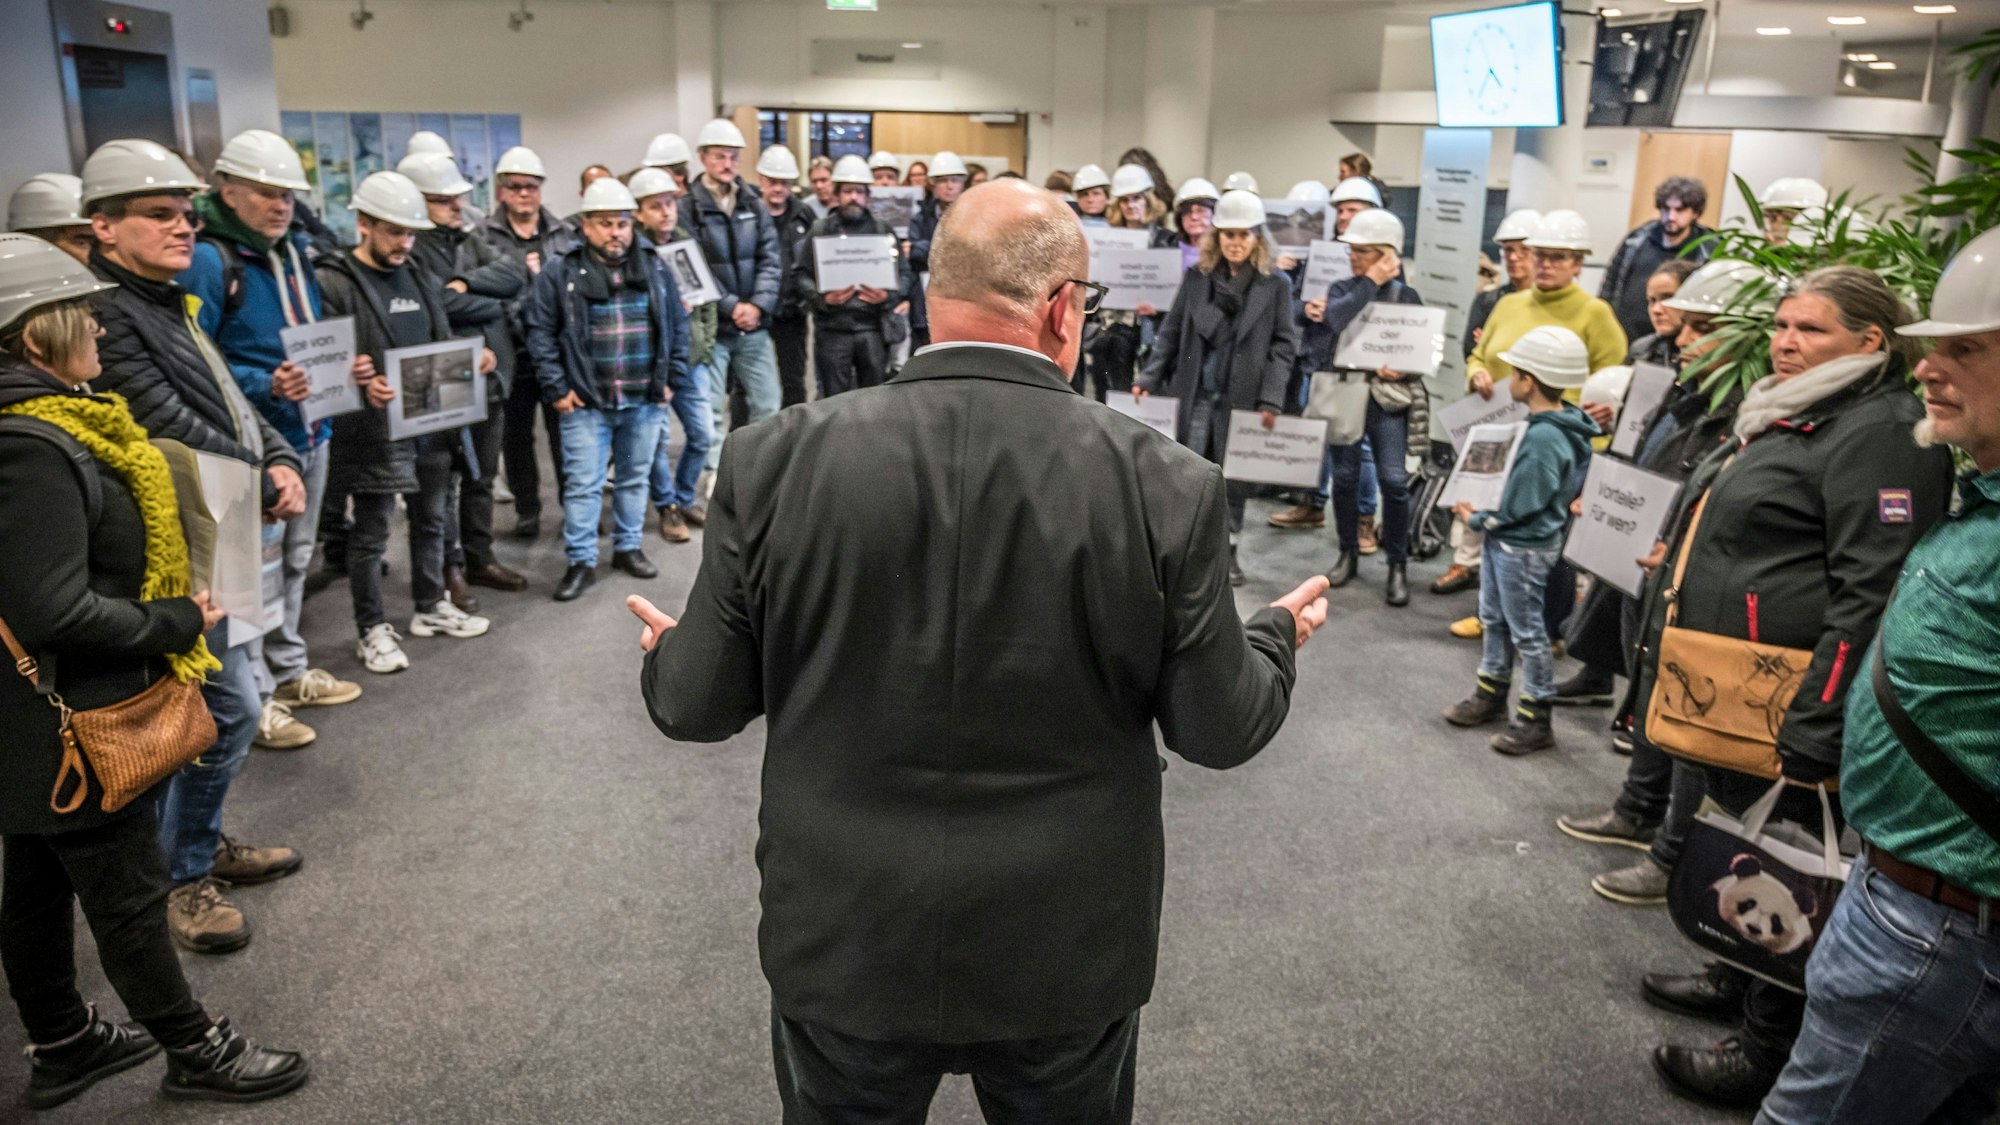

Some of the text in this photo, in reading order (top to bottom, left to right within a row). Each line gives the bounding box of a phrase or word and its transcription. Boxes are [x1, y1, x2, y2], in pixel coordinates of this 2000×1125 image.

[1361, 314, 1429, 328] Ausverkauf
[311, 335, 335, 347] von
[1380, 331, 1400, 340] der
[1361, 342, 1414, 354] Stadt???
[1598, 483, 1646, 512] Vorteile?
[1590, 503, 1638, 537] Für wen?
